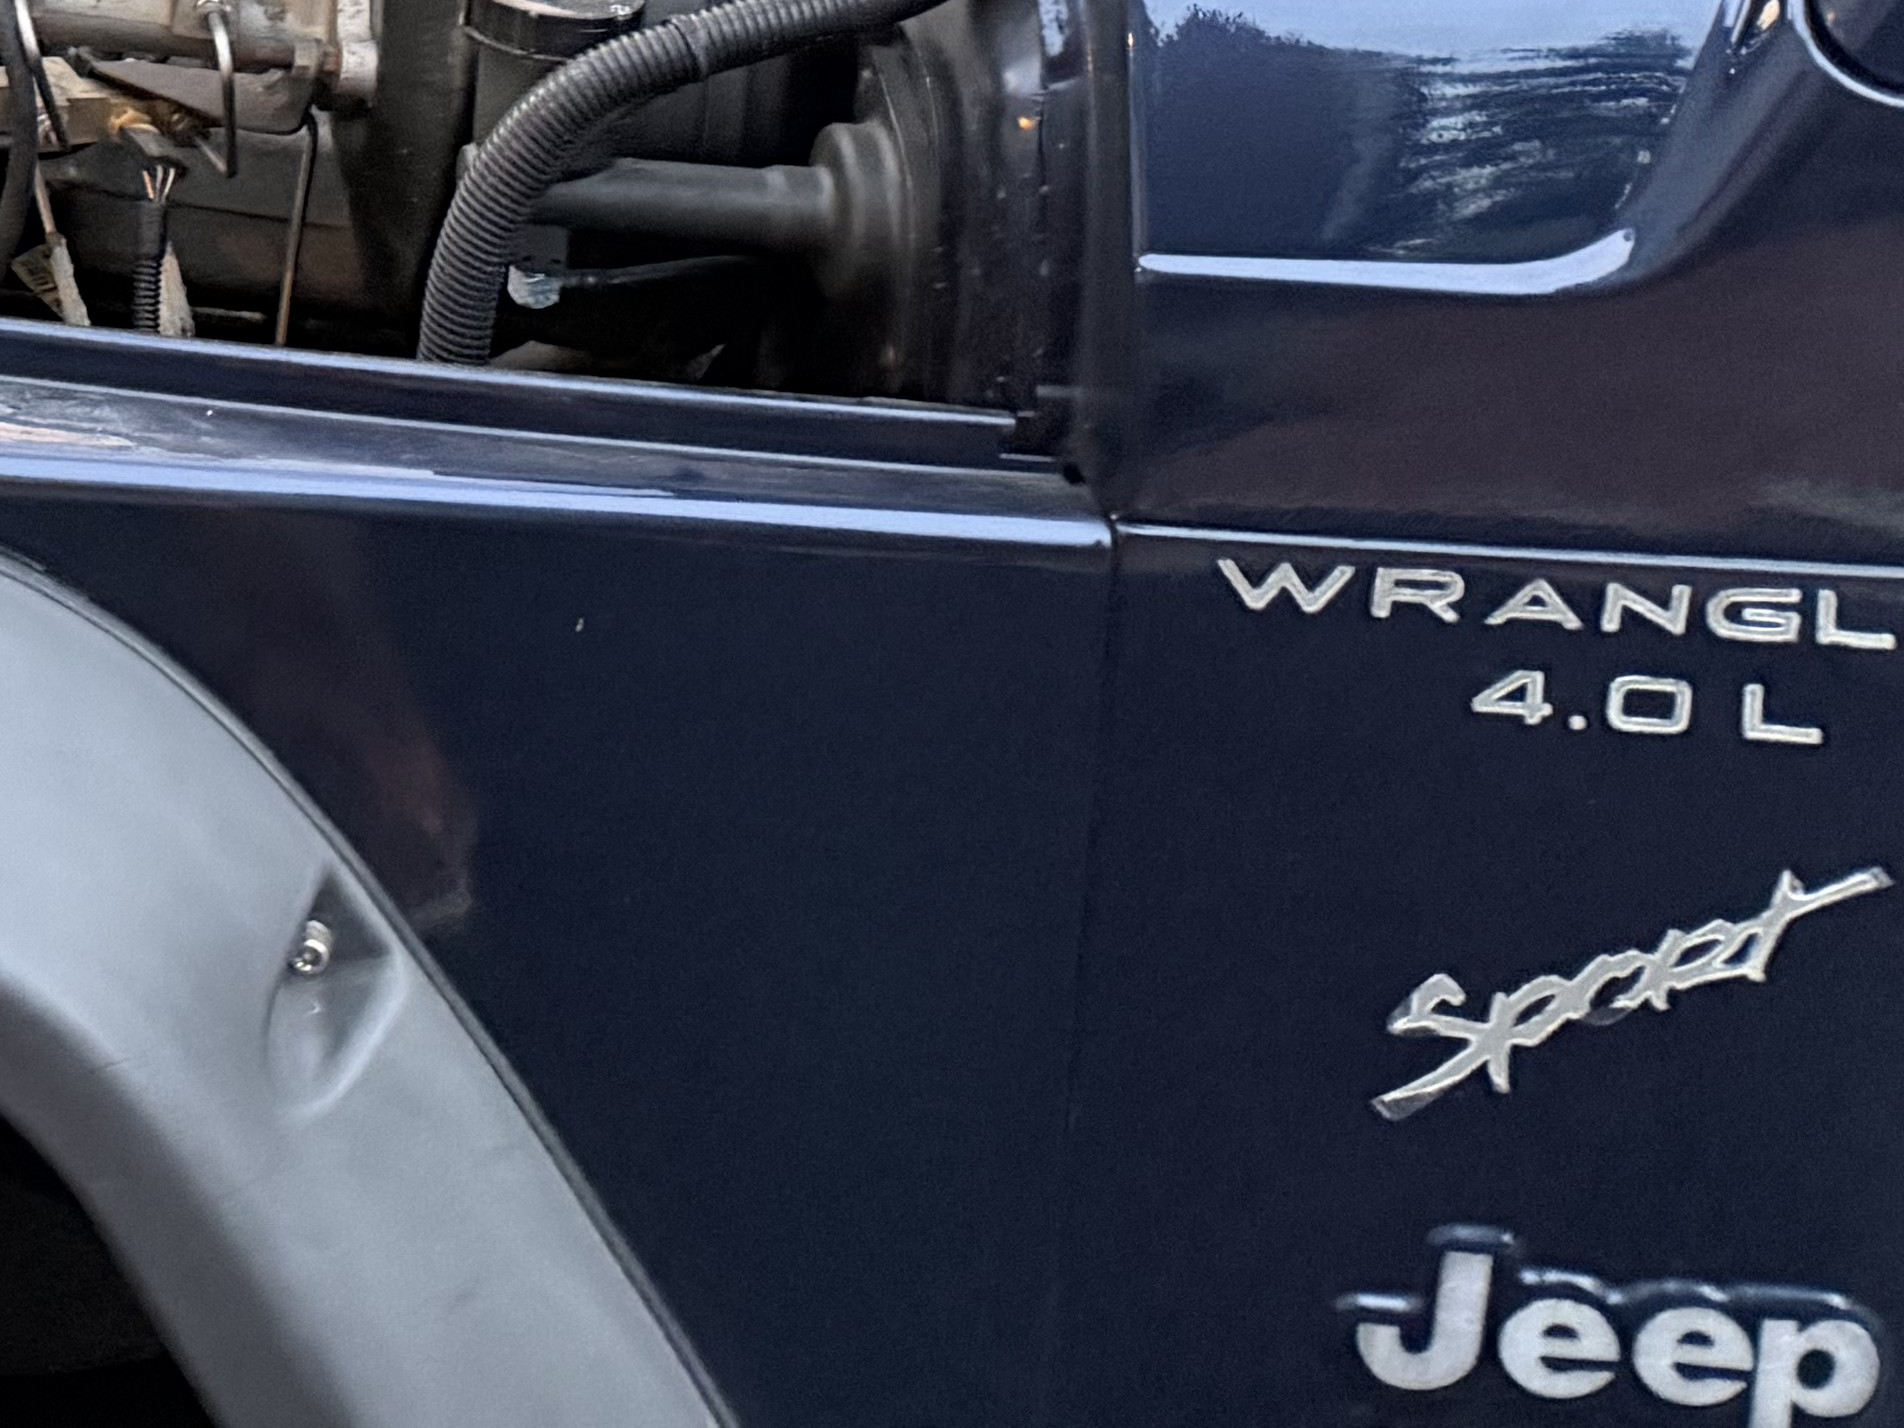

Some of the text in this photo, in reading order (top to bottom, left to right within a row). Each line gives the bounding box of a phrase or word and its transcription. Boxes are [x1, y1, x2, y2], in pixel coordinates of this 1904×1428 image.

[1216, 558, 1897, 649] WRANGL
[1369, 866, 1895, 1121] Sport
[1356, 1249, 1881, 1428] Jeep
